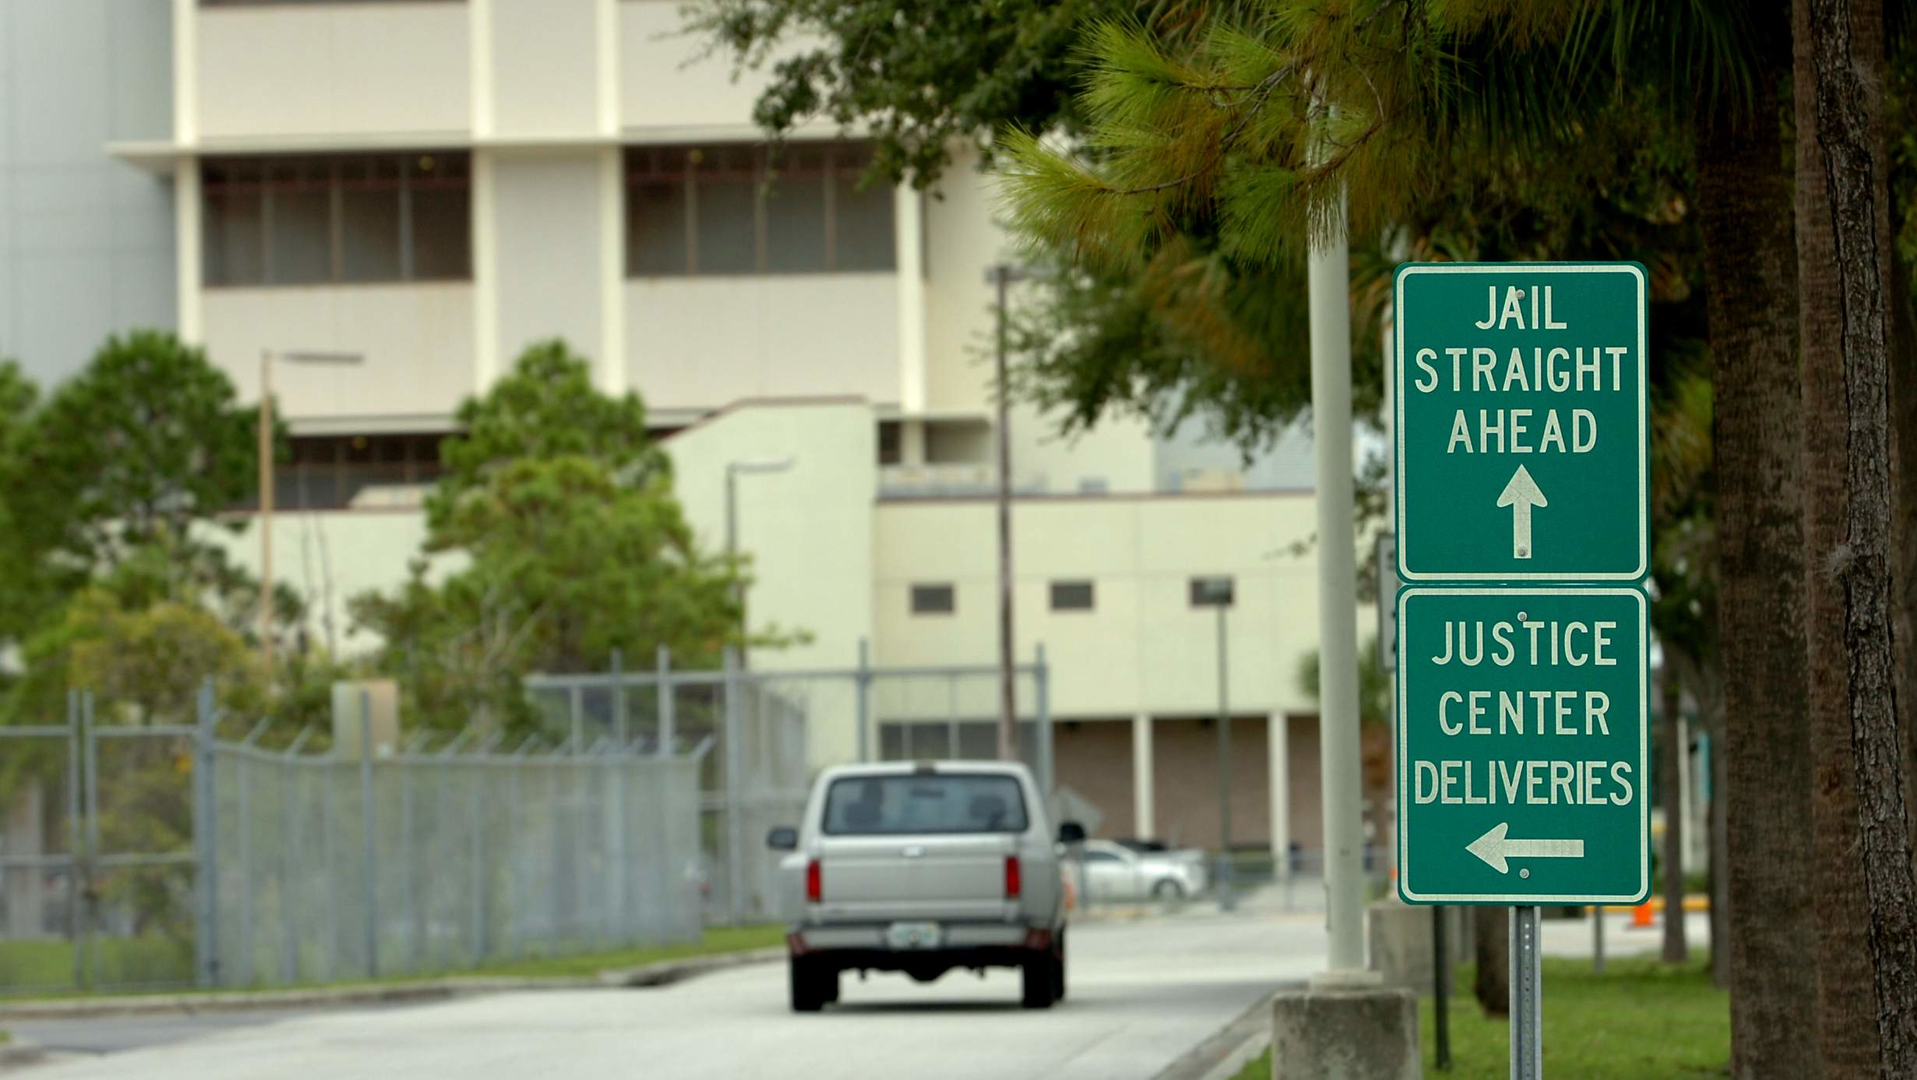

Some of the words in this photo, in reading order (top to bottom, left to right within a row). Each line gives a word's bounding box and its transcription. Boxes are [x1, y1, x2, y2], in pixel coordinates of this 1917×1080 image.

[1475, 285, 1567, 330] JAIL
[1415, 347, 1628, 393] STRAIGHT
[1447, 409, 1597, 454] AHEAD
[1431, 621, 1617, 667] JUSTICE
[1438, 691, 1610, 736] CENTER
[1414, 760, 1633, 806] DELIVERIES
